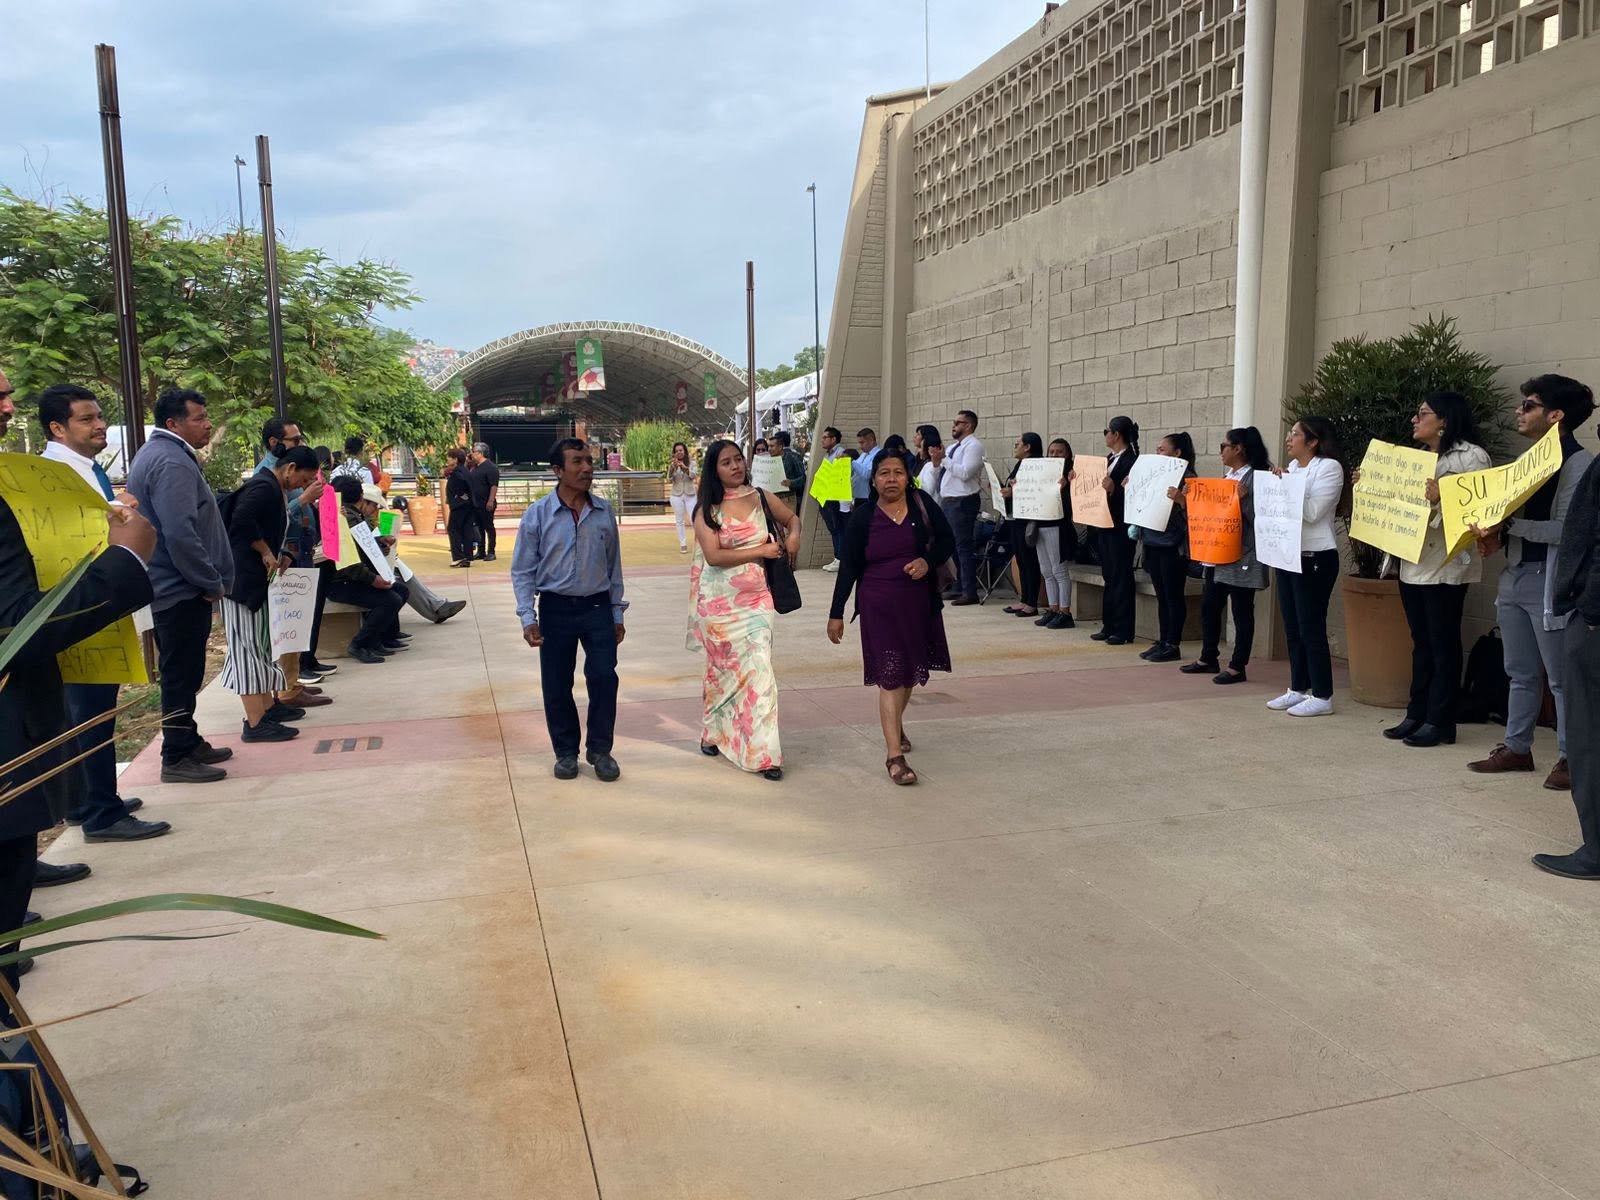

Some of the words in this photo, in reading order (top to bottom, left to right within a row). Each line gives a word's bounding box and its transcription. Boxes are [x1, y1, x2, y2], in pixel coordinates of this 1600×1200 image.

[1456, 475, 1487, 507] SU
[1497, 436, 1552, 491] TRIUNFO
[1461, 509, 1481, 527] es
